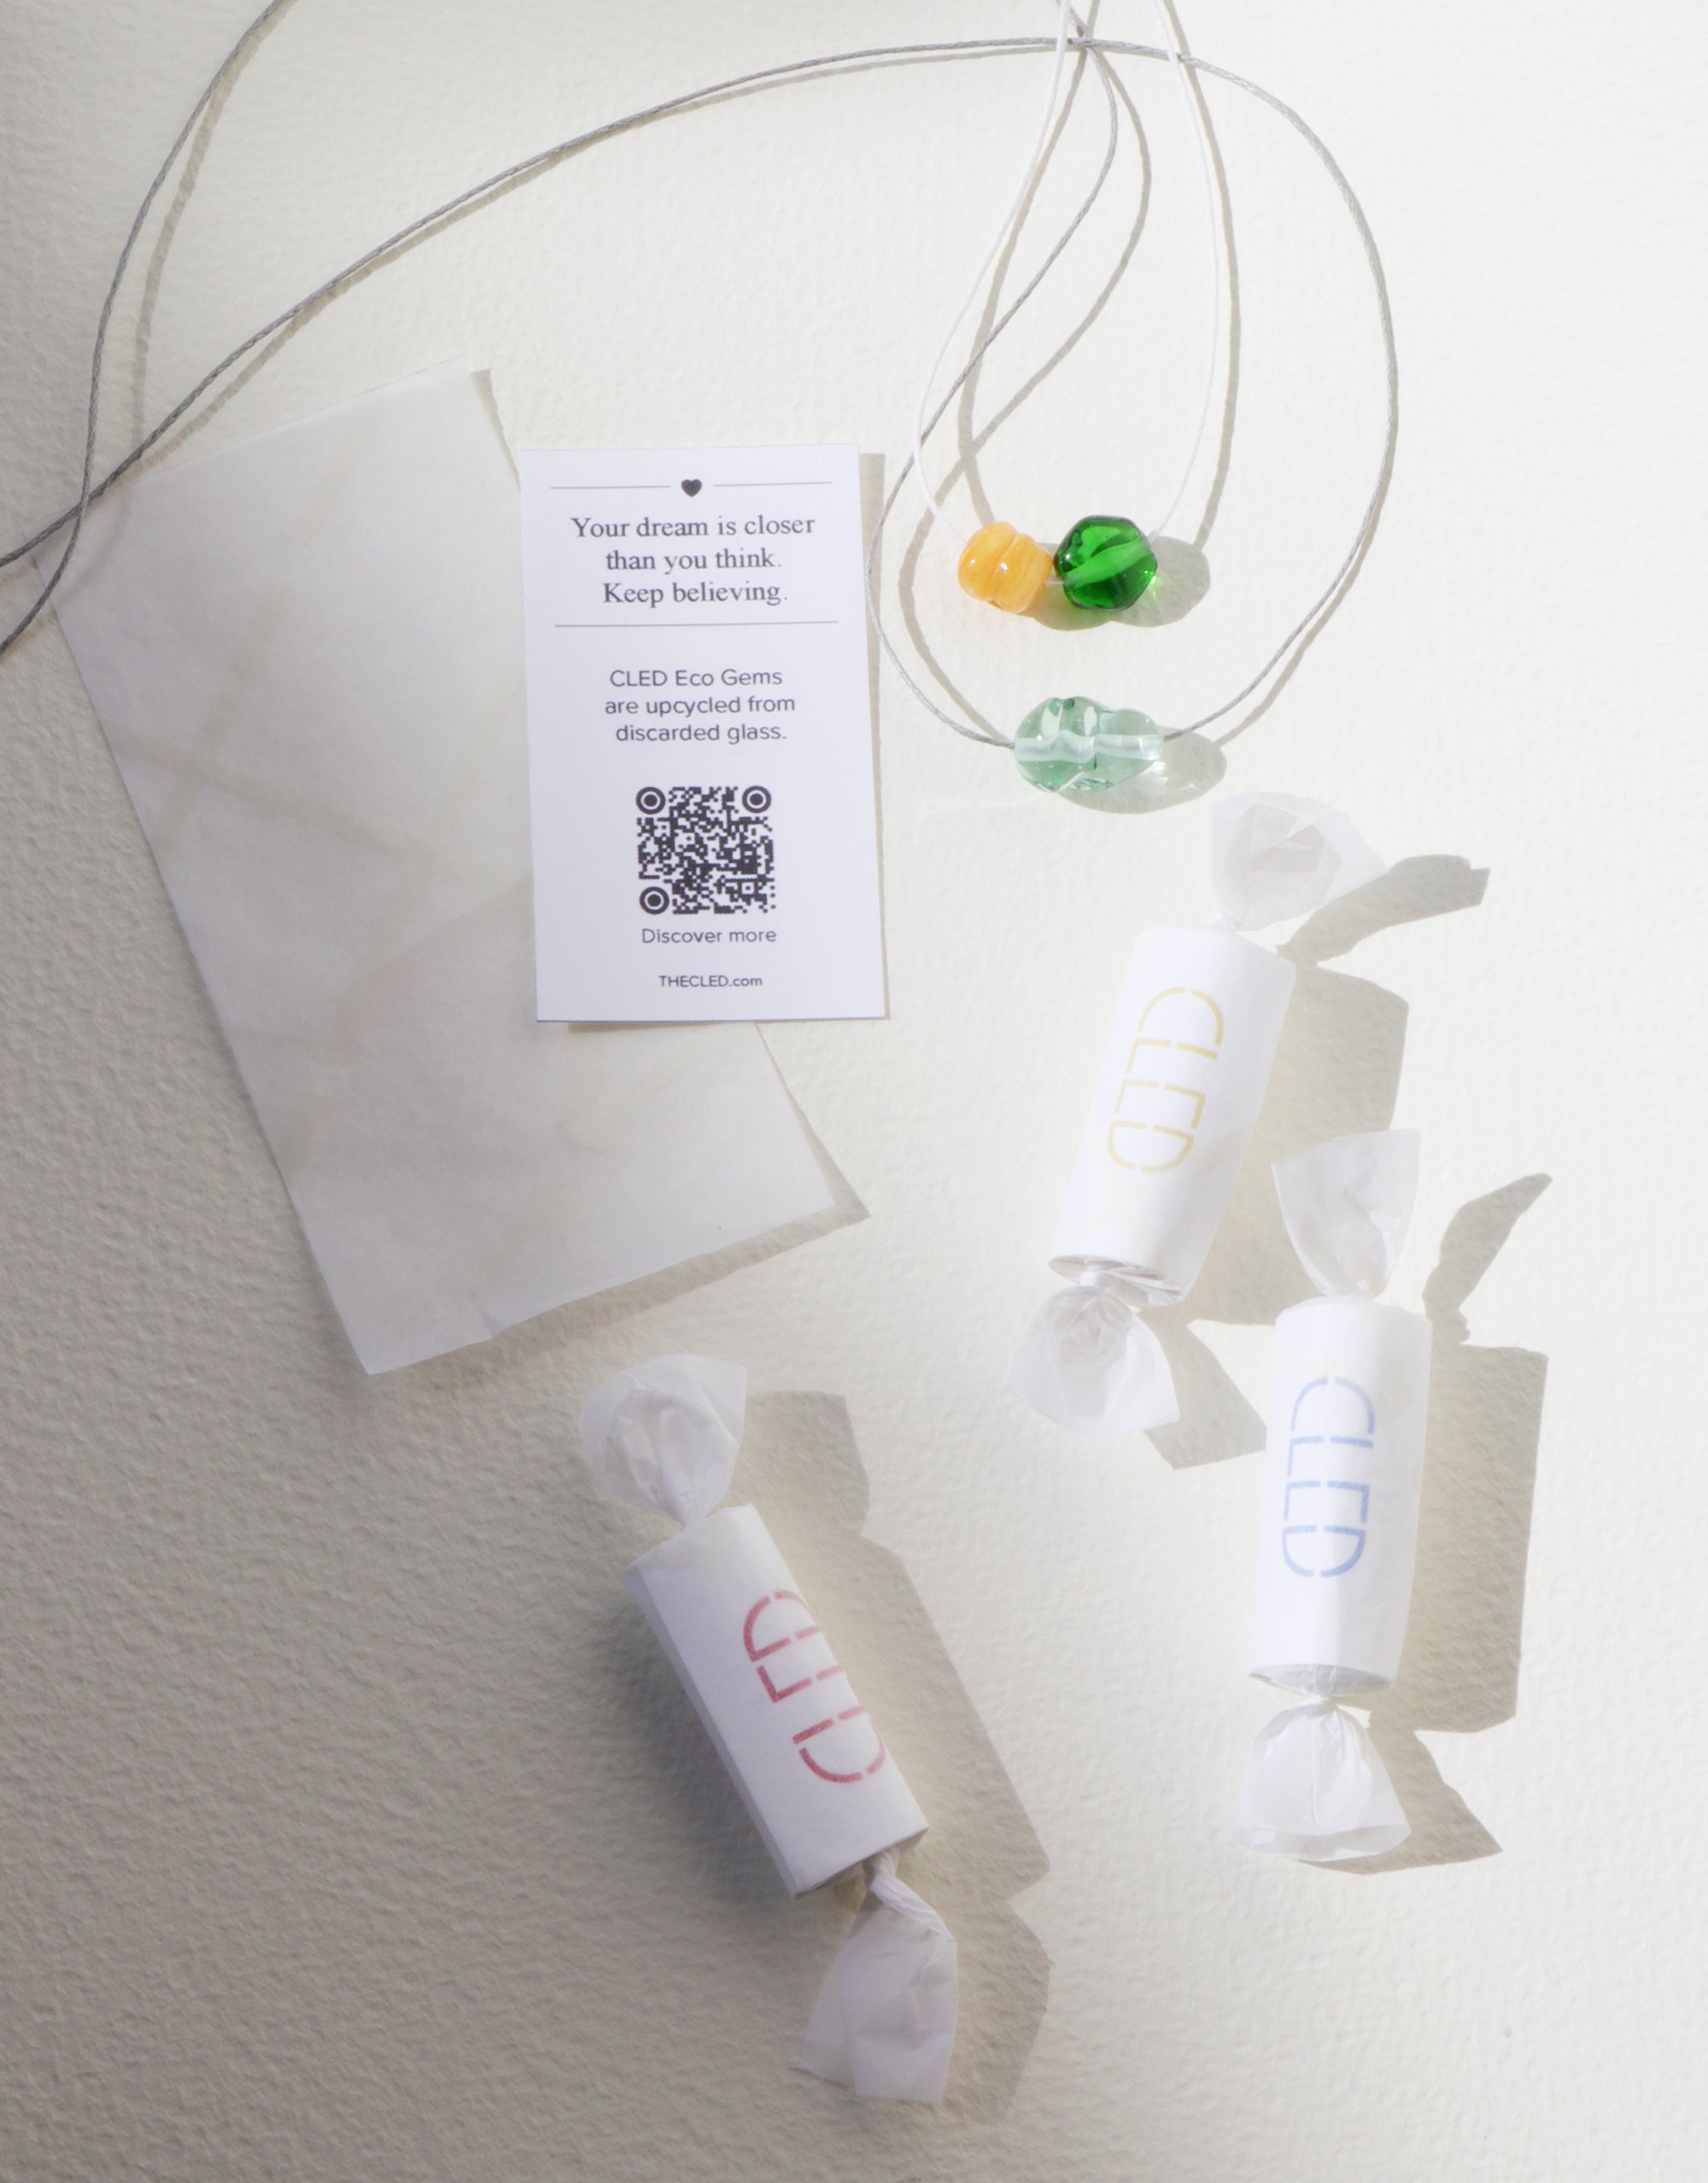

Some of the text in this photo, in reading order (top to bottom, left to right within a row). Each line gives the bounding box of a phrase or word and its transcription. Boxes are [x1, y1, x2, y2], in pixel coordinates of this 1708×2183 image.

[570, 514, 816, 538] Your dream is closer
[605, 547, 782, 575] than you think.
[603, 581, 788, 609] Keep believing.
[609, 668, 783, 688] CLED Eco Gems
[605, 695, 796, 718] are upcycled from
[615, 723, 787, 746] discarded glass.
[640, 928, 777, 944] Discover more
[658, 974, 763, 988] THECLED.com
[1108, 986, 1225, 1173] CLED
[1282, 1376, 1376, 1577] CLED
